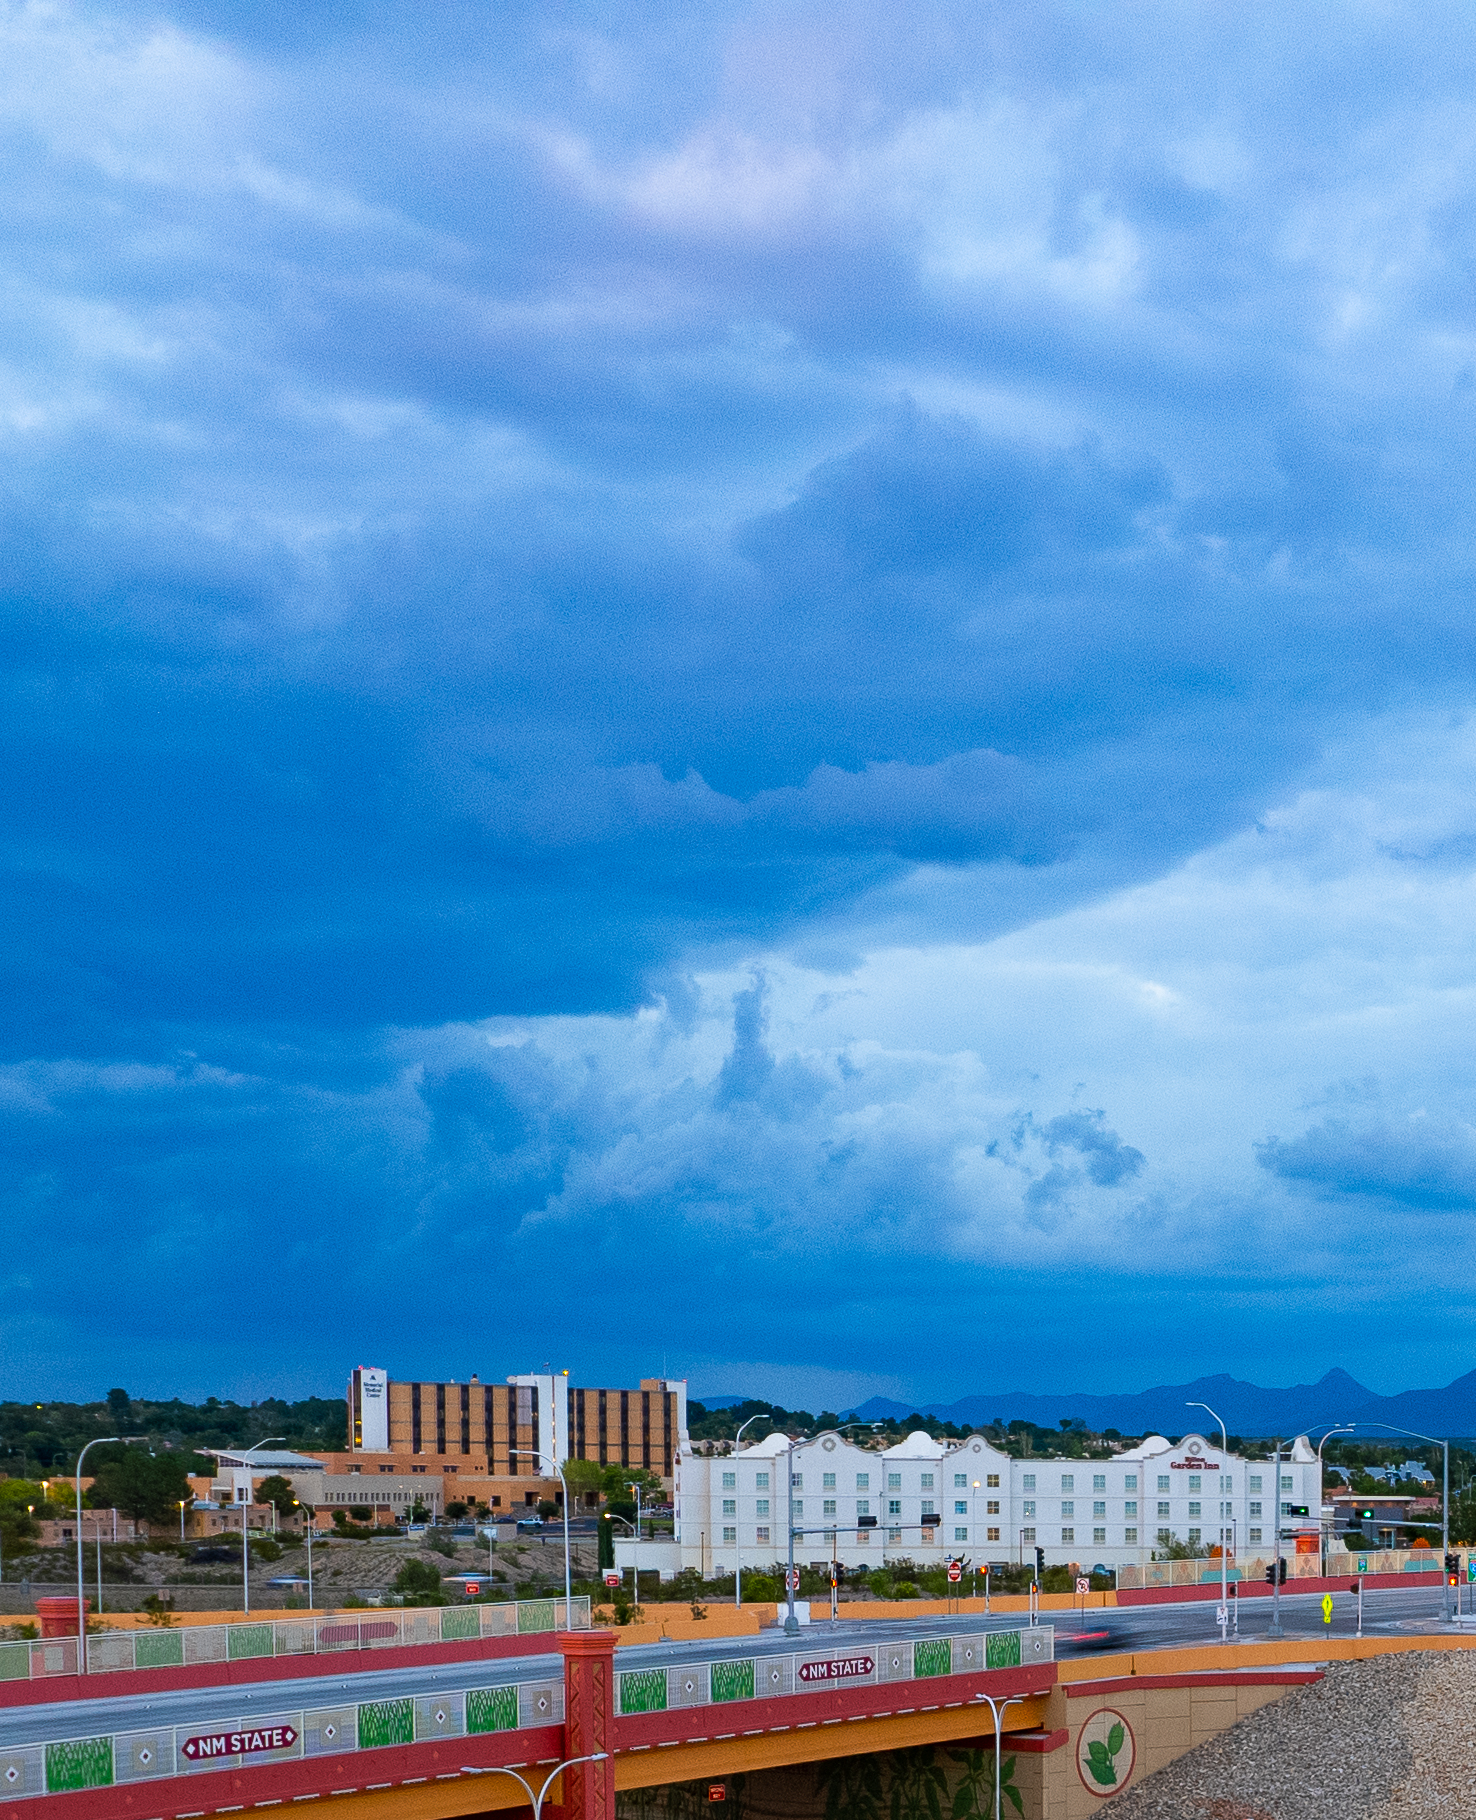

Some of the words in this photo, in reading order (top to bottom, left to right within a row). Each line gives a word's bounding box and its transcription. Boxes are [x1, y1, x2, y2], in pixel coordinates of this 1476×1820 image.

[1170, 1461, 1202, 1470] Garden
[1204, 1461, 1220, 1470] Inn
[809, 1663, 828, 1679] NM
[830, 1660, 865, 1676] STATE
[199, 1736, 226, 1756] NM
[231, 1729, 283, 1751] STATE
